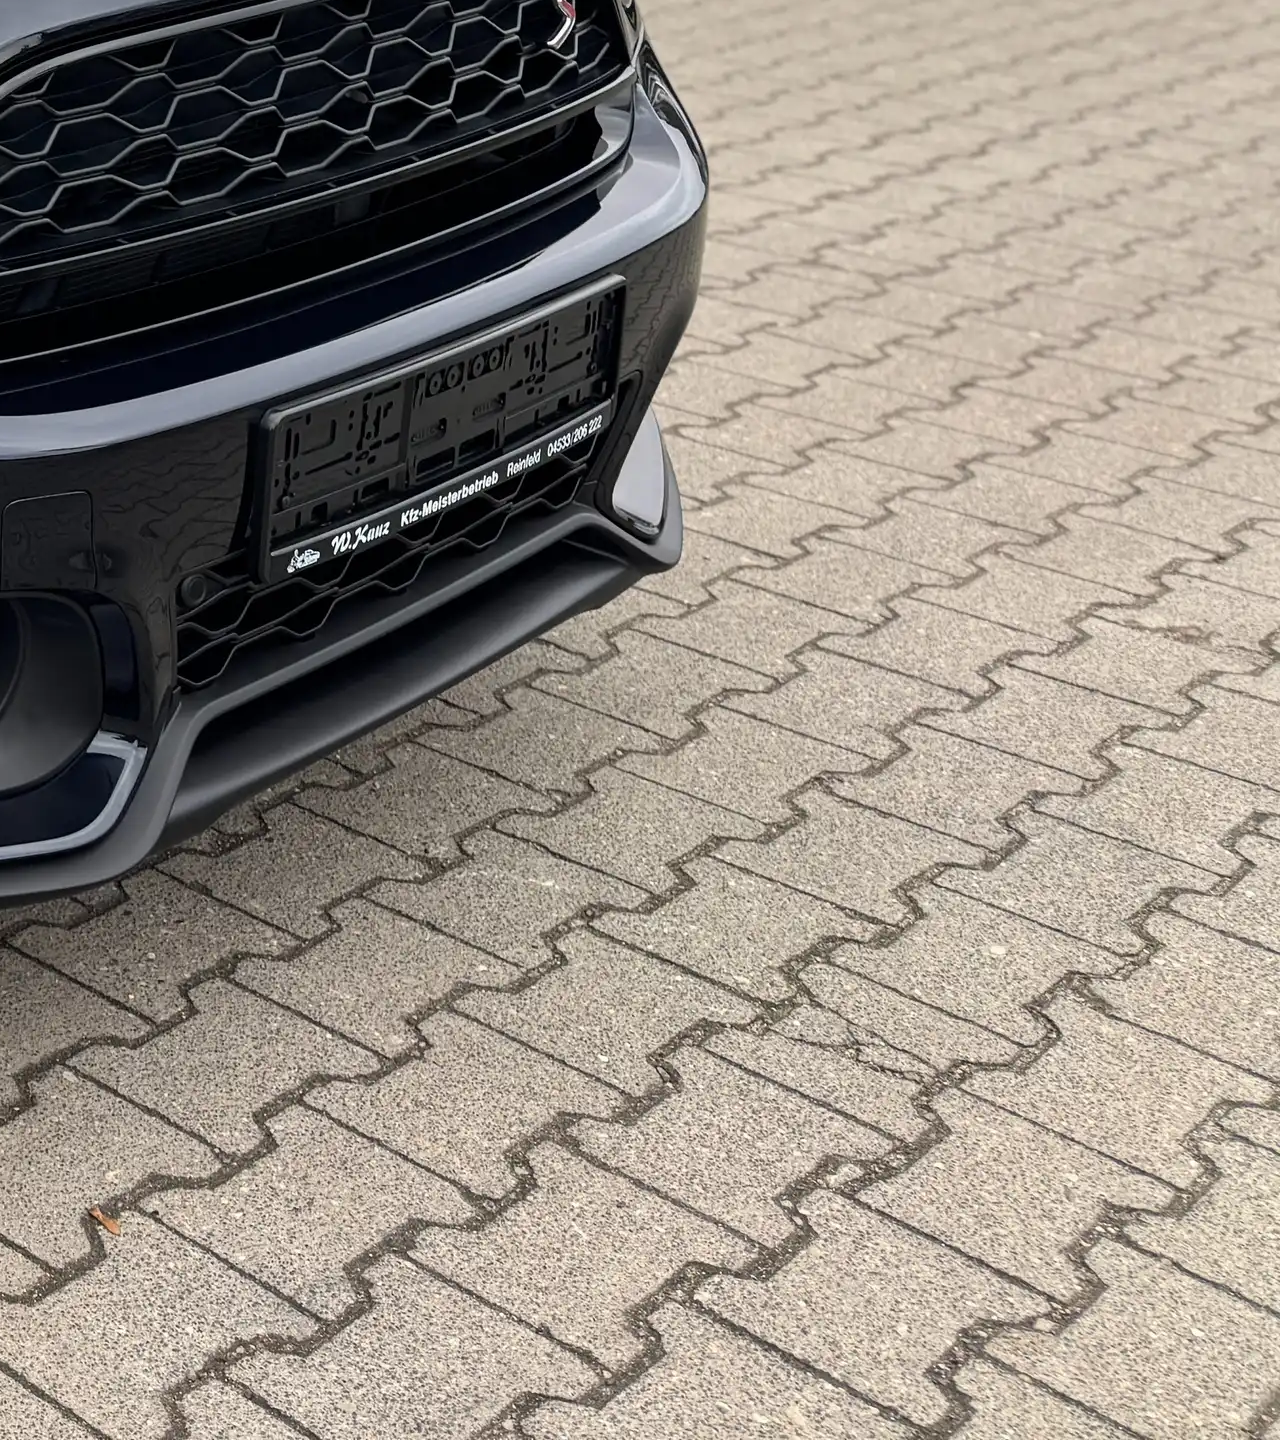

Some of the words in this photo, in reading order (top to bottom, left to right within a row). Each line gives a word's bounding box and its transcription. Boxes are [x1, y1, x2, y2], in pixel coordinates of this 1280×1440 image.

[399, 470, 500, 527] Kfz-Meisterbetrieb
[506, 448, 542, 477] Reinfeld
[588, 414, 603, 436] 222
